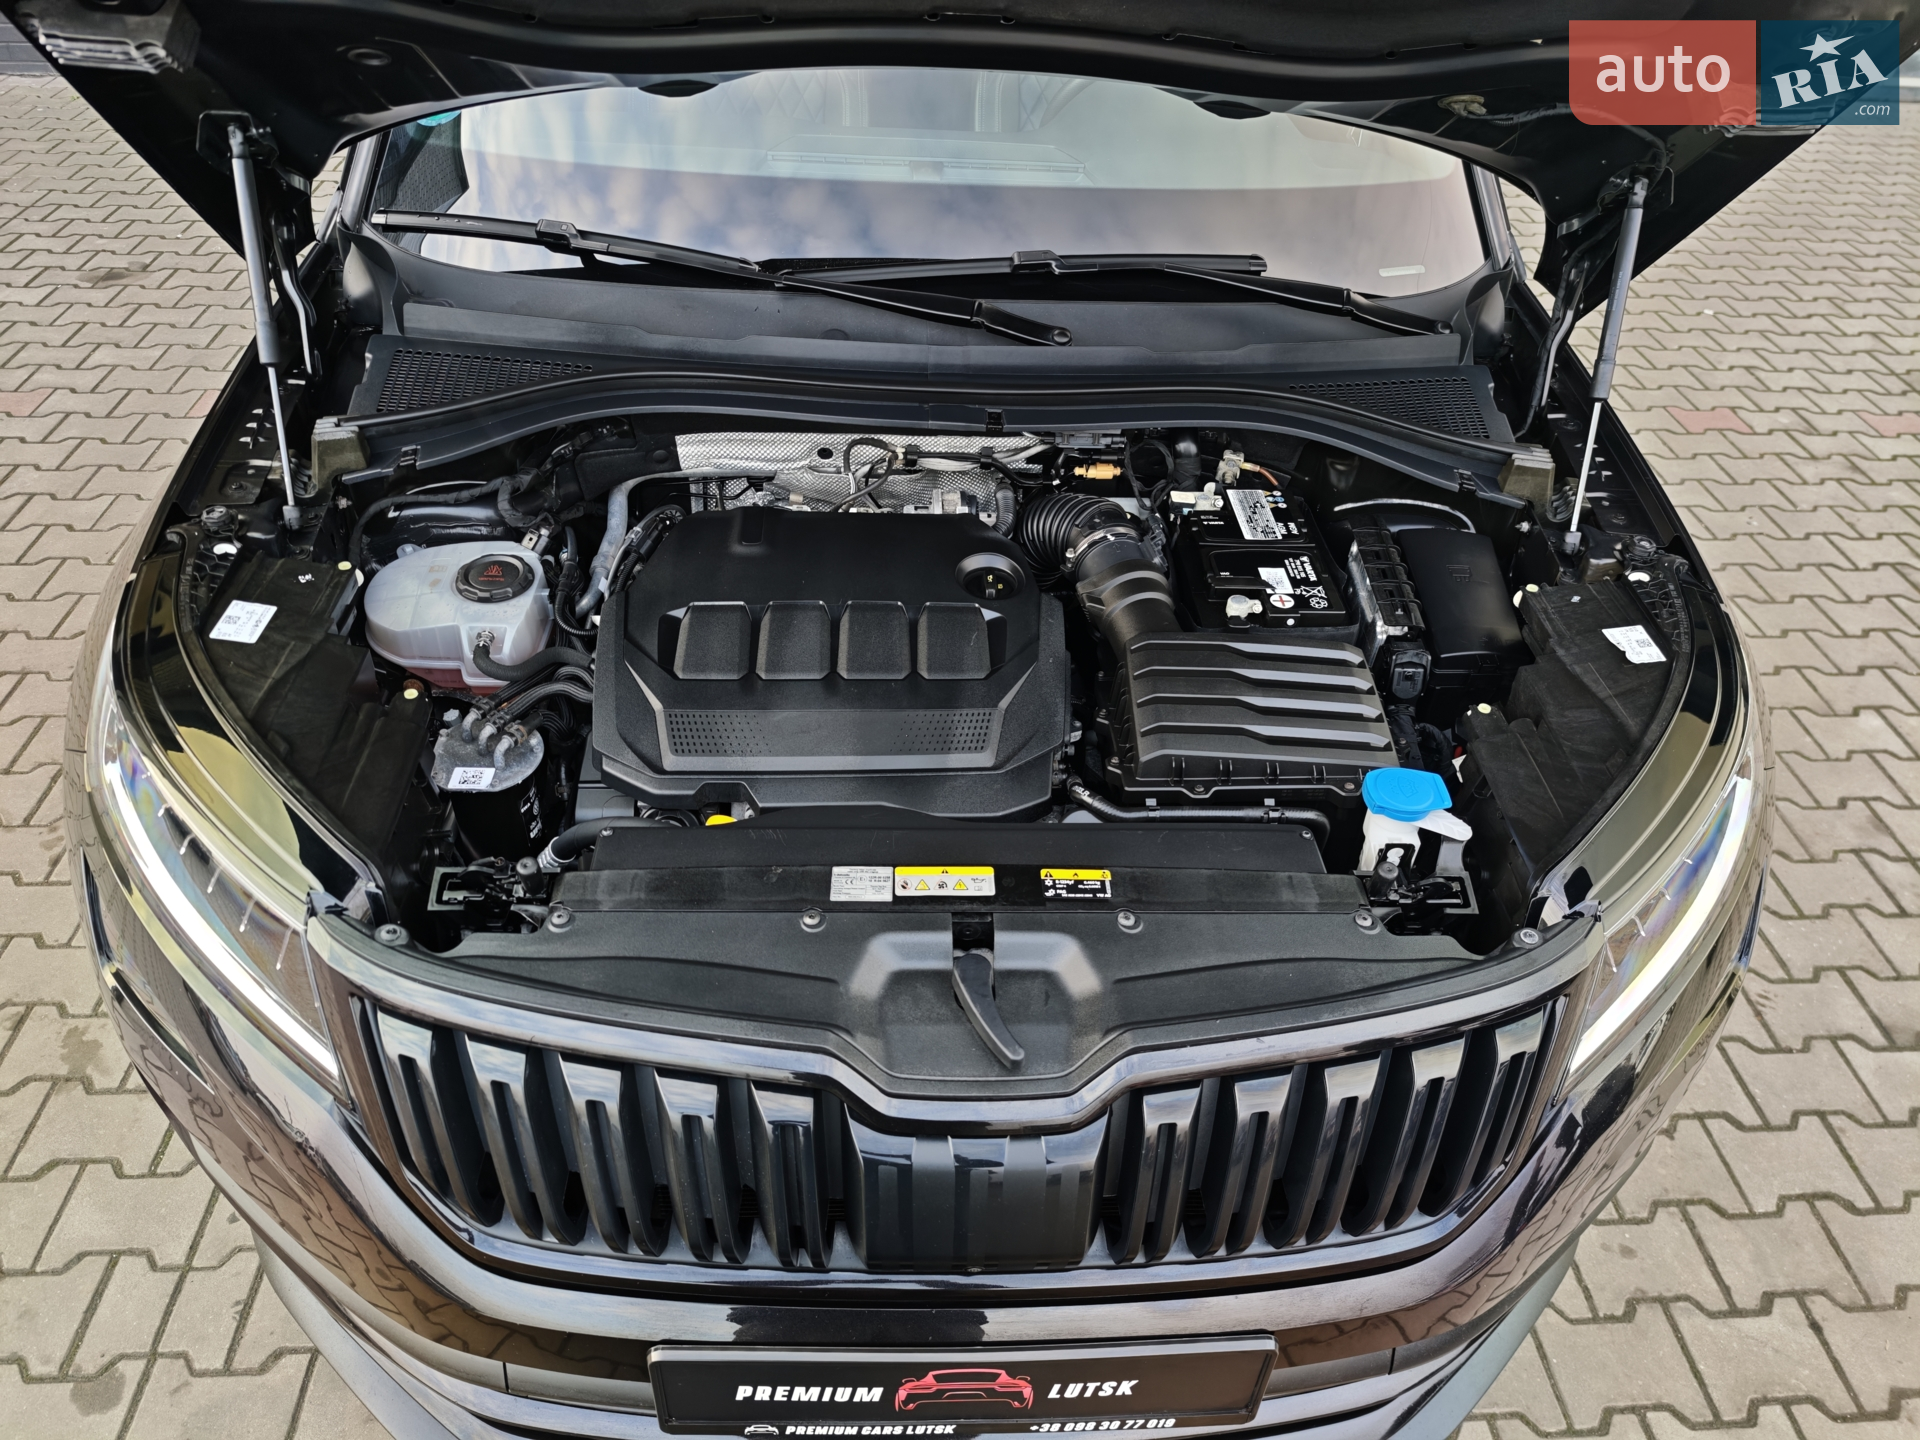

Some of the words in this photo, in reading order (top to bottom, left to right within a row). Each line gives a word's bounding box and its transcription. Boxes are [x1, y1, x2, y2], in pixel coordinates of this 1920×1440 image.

[735, 1385, 884, 1402] PREMIUM
[1047, 1379, 1139, 1399] LUTSK
[785, 1425, 858, 1435] PREMIUM
[861, 1425, 903, 1435] CARS
[905, 1424, 956, 1435] LUTSK
[1030, 1423, 1061, 1432] +38
[1063, 1421, 1097, 1432] 098
[1098, 1420, 1121, 1430] 30
[1123, 1419, 1146, 1430] 77
[1146, 1418, 1176, 1429] 019
